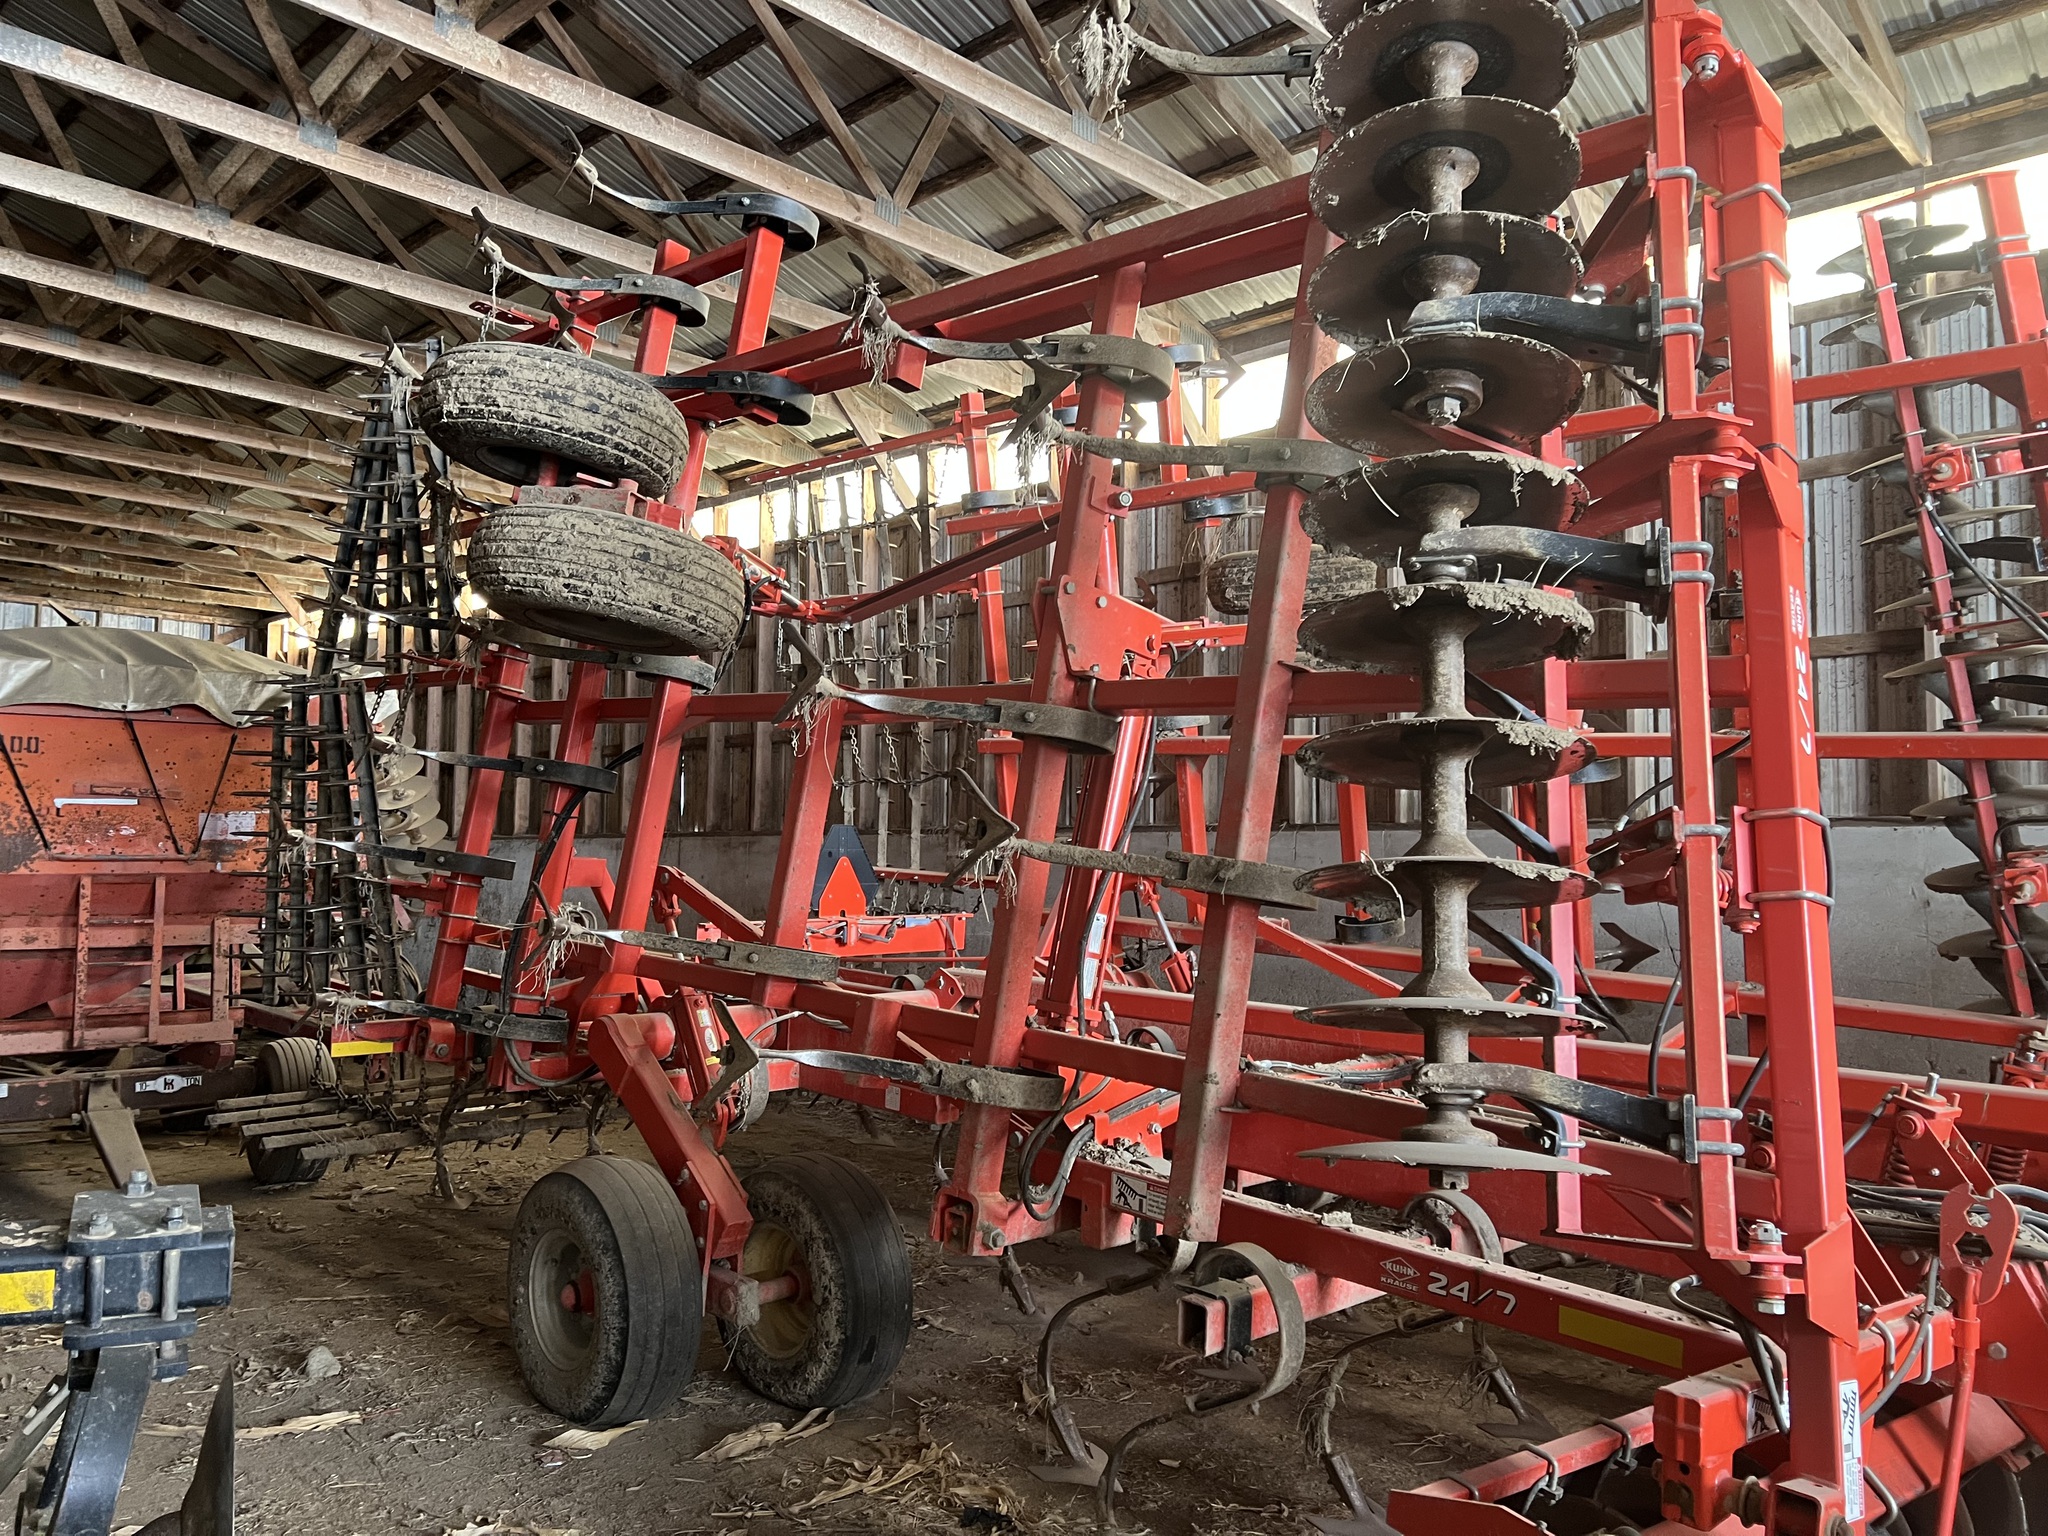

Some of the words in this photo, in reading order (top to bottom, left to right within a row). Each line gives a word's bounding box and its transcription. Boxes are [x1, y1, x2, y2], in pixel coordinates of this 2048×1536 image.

[1795, 645, 1811, 755] 24/7
[2, 734, 39, 753] 00
[1386, 1261, 1414, 1276] KUHN
[1381, 1276, 1419, 1292] KRAUSE
[1428, 1271, 1516, 1315] 24/7
